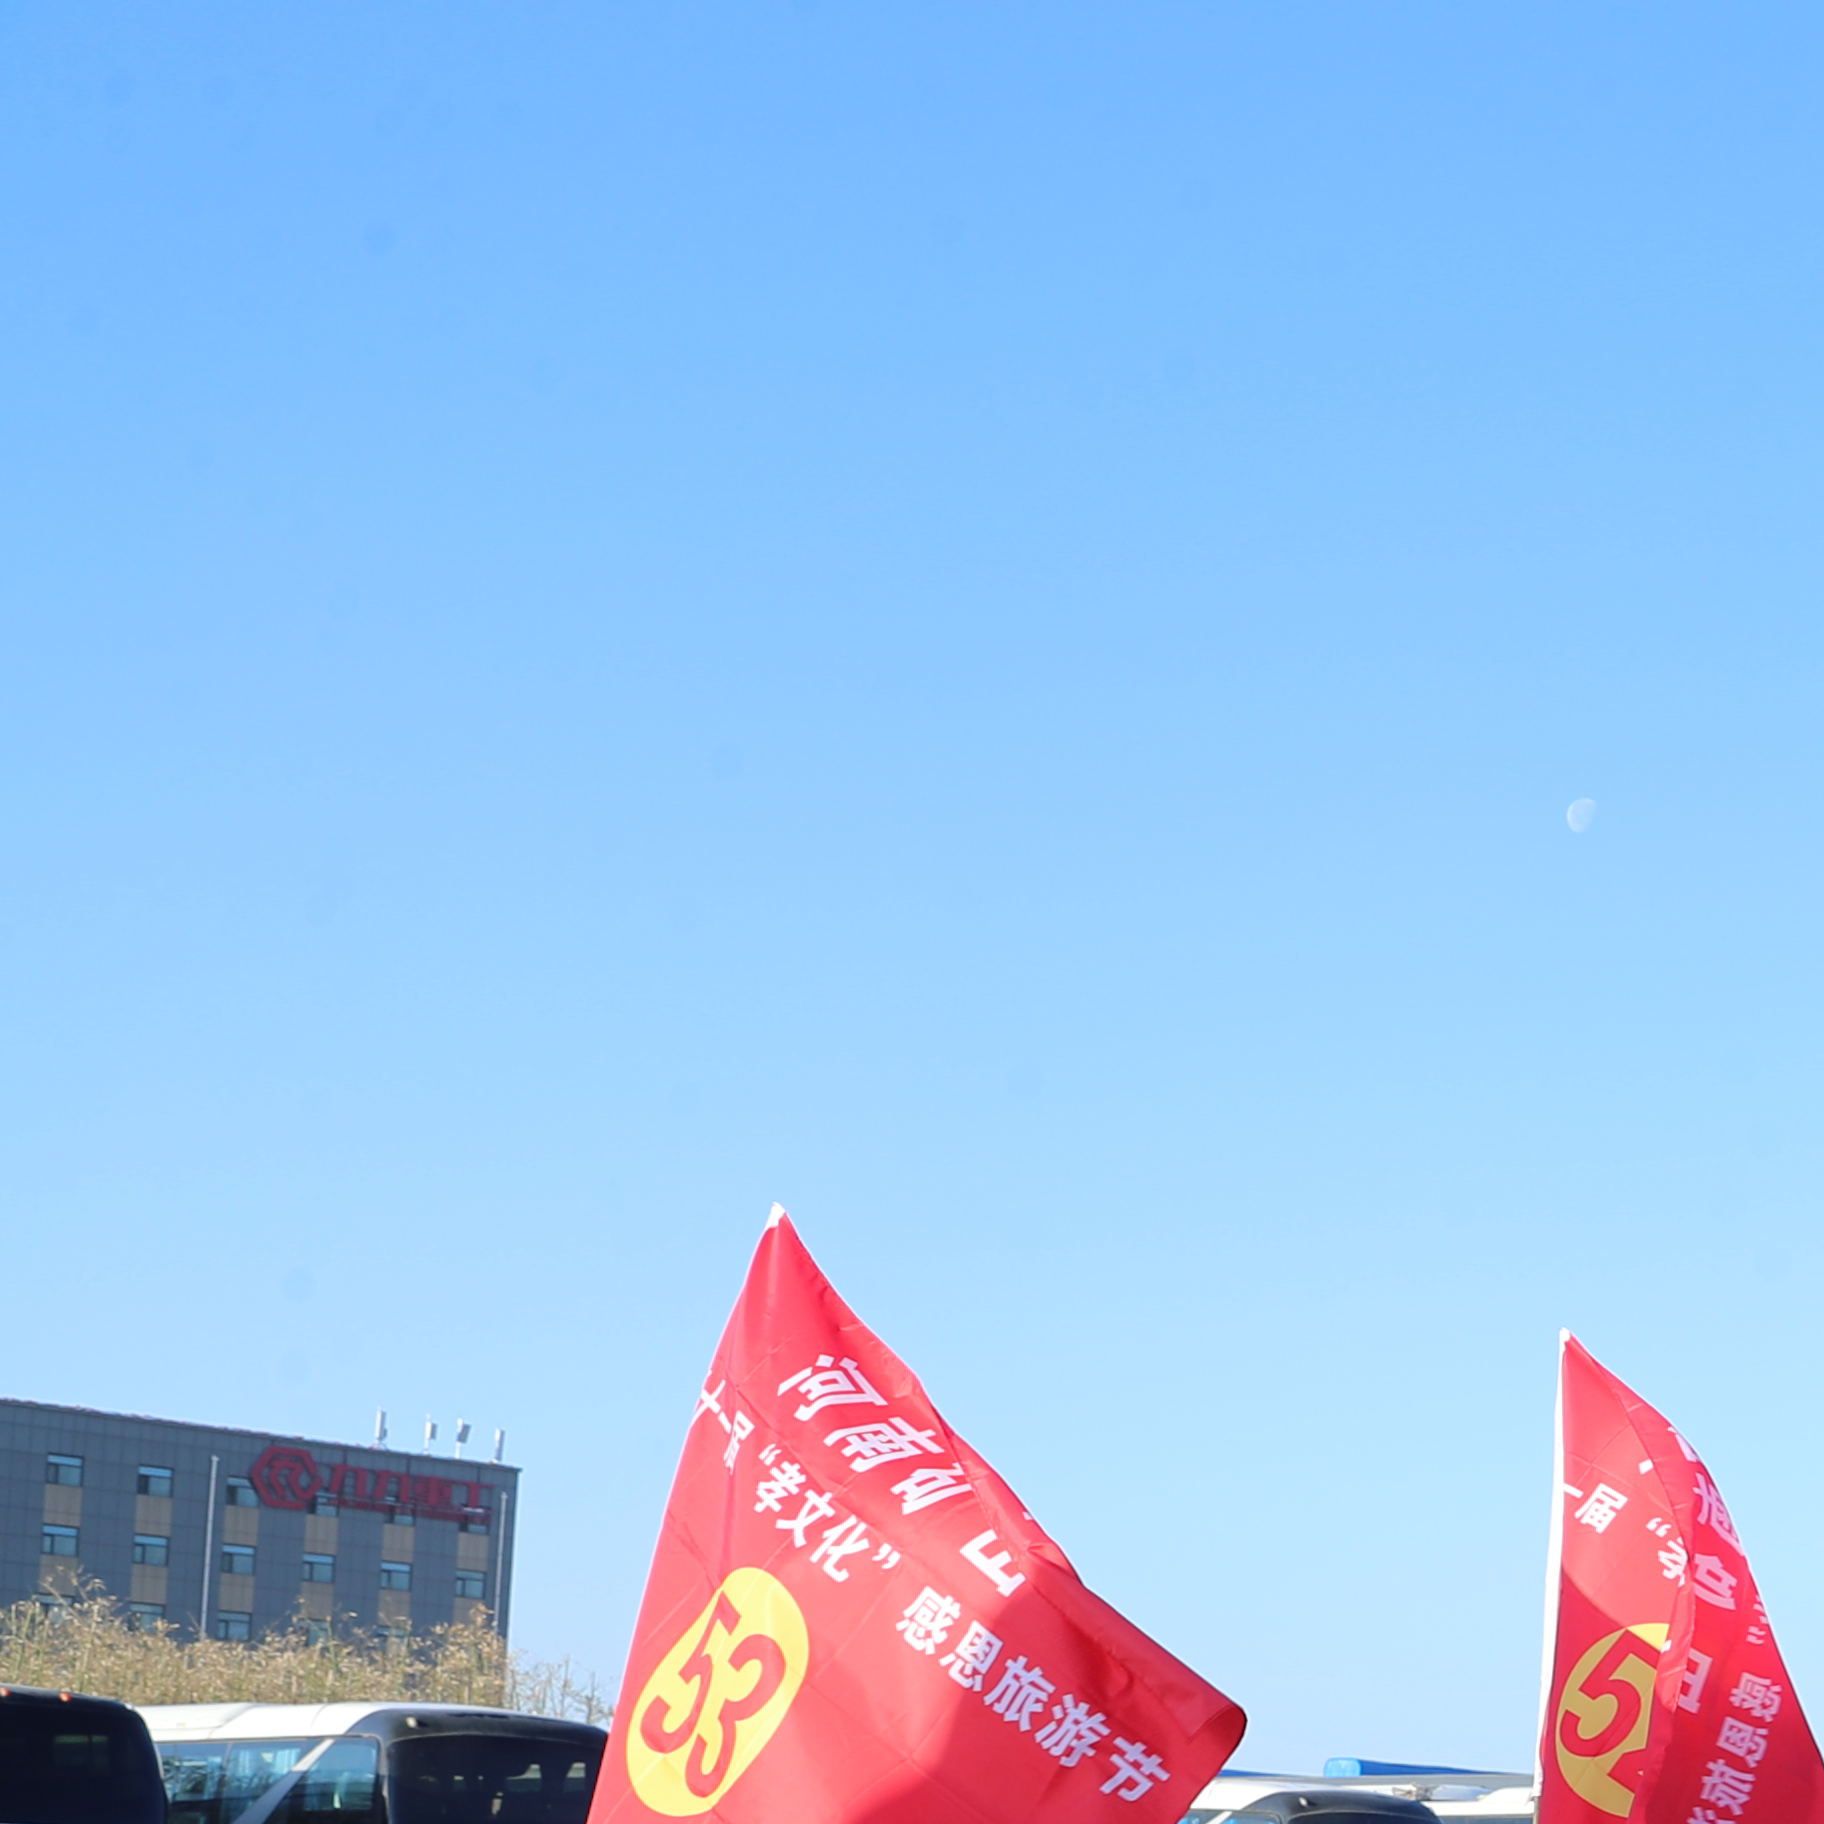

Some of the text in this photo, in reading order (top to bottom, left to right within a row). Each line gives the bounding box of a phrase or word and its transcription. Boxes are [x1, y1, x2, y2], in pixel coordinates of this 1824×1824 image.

[638, 1592, 788, 1799] 53
[895, 1586, 1170, 1802] 感恩旅游节
